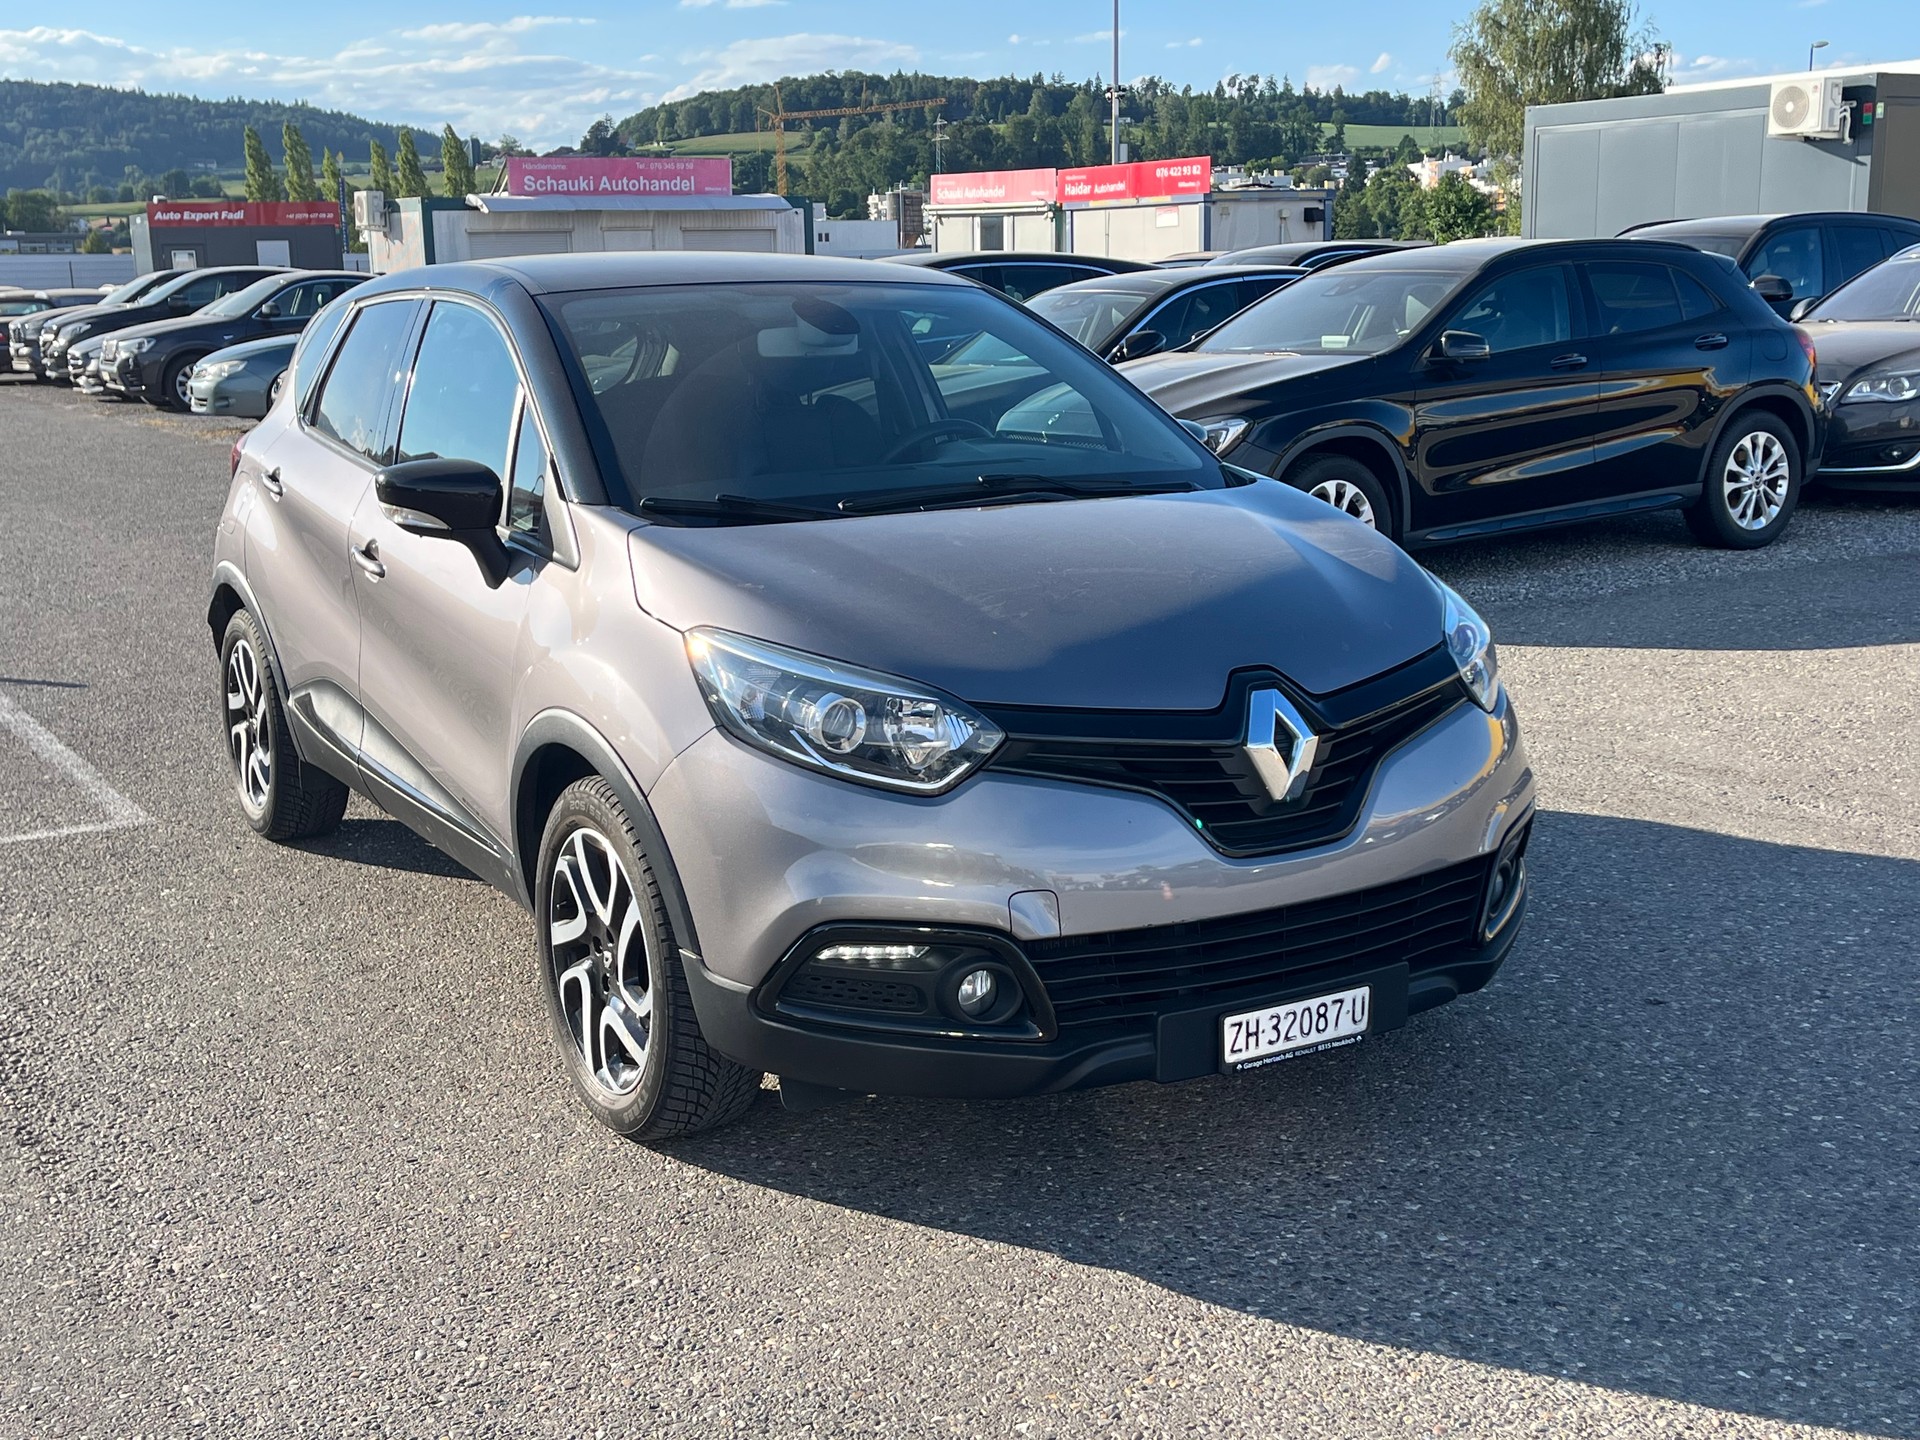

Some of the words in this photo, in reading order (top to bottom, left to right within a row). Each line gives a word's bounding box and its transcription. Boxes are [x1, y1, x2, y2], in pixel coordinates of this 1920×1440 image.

[1156, 167, 1169, 178] 076
[1170, 165, 1182, 177] 422
[1182, 165, 1191, 176] 93
[523, 175, 594, 192] Schauki
[599, 175, 695, 192] Autohandel
[1064, 181, 1092, 196] Haidar
[1093, 180, 1126, 195] Autohandel
[964, 185, 1005, 198] Autohandel
[154, 210, 181, 220] Auto
[182, 210, 219, 222] Export
[221, 209, 244, 220] Fadi
[1243, 1060, 1263, 1069] Garage
[1285, 1051, 1294, 1059] AG
